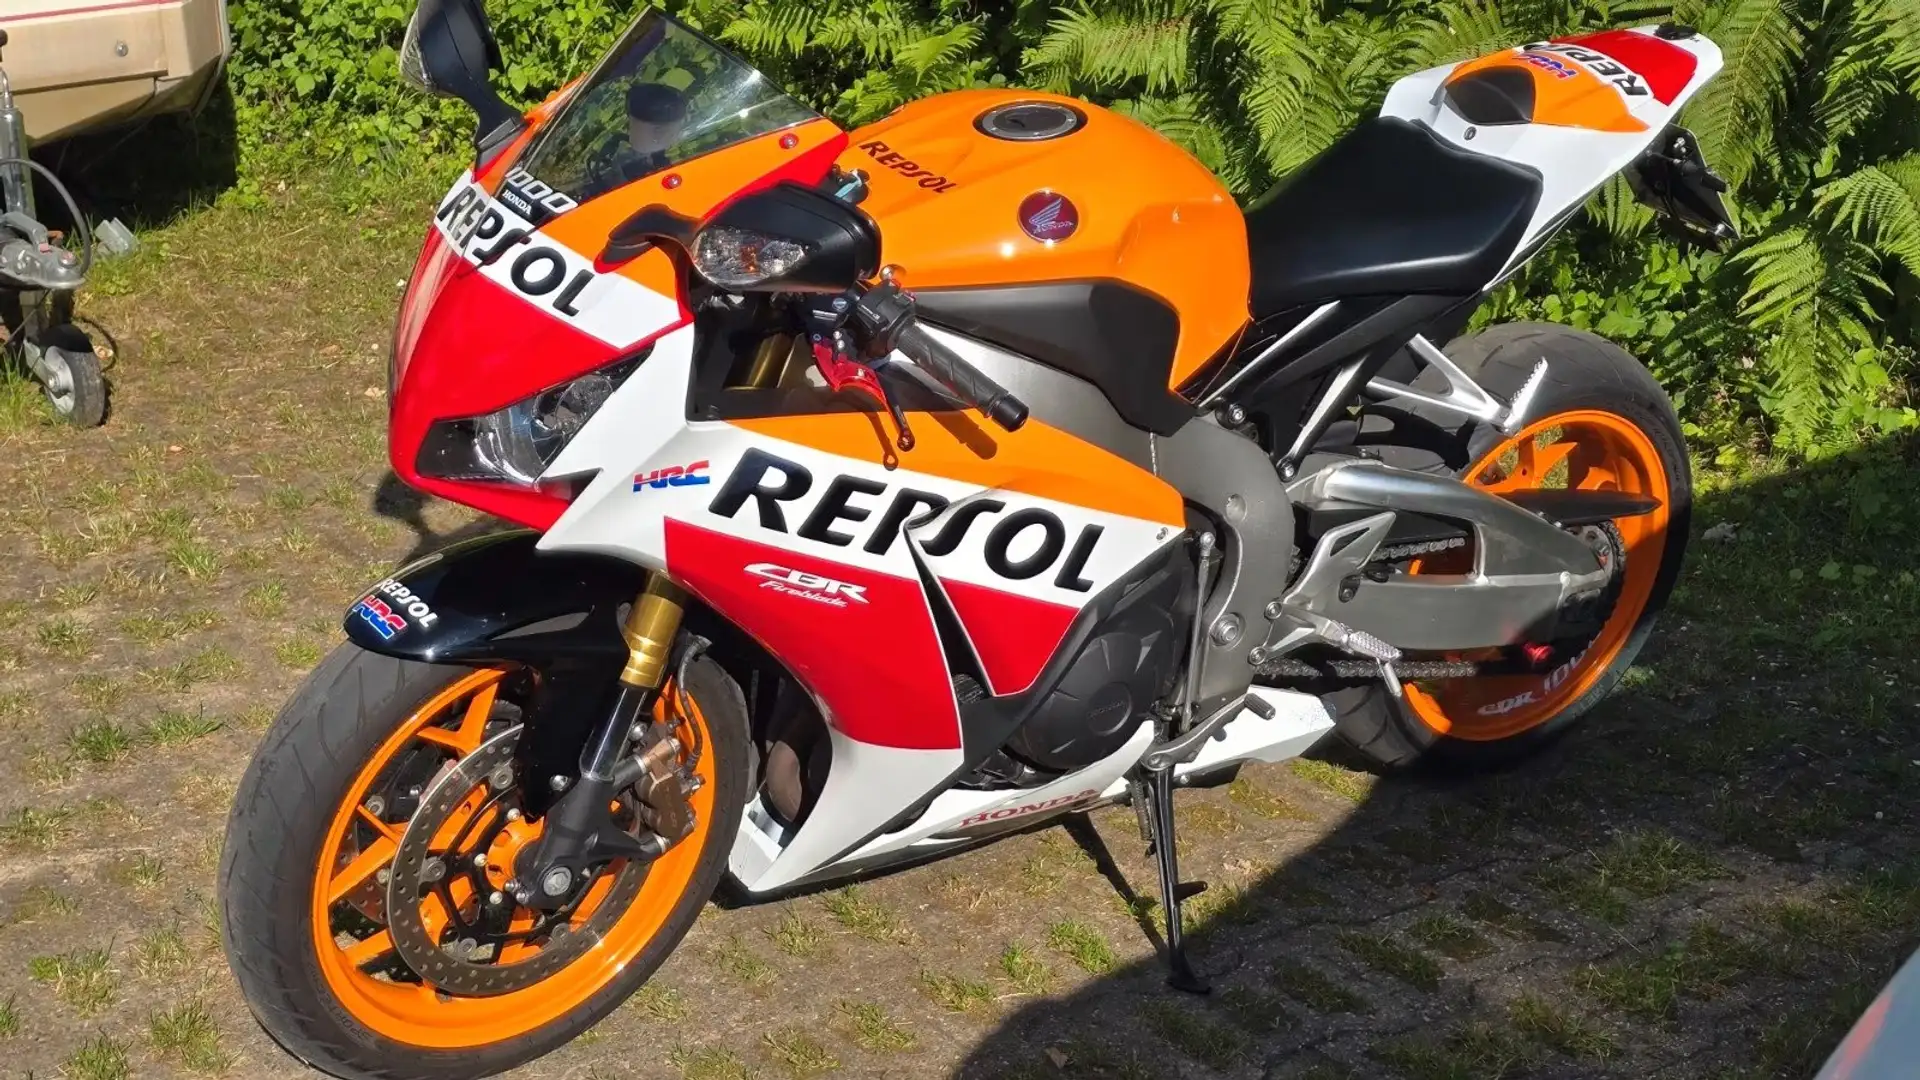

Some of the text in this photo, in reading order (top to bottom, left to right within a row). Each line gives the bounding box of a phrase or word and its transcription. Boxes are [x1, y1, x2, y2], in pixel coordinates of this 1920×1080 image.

[504, 166, 579, 214] 1000
[859, 140, 957, 194] REPSOL
[502, 189, 532, 215] HONDA
[437, 185, 595, 317] REPSOL
[632, 460, 710, 493] HRC
[708, 446, 1105, 593] REPSOL
[379, 578, 438, 628] REPSOL
[743, 563, 870, 604] CBR
[352, 594, 408, 640] HRC
[960, 788, 1098, 827] HONDA
